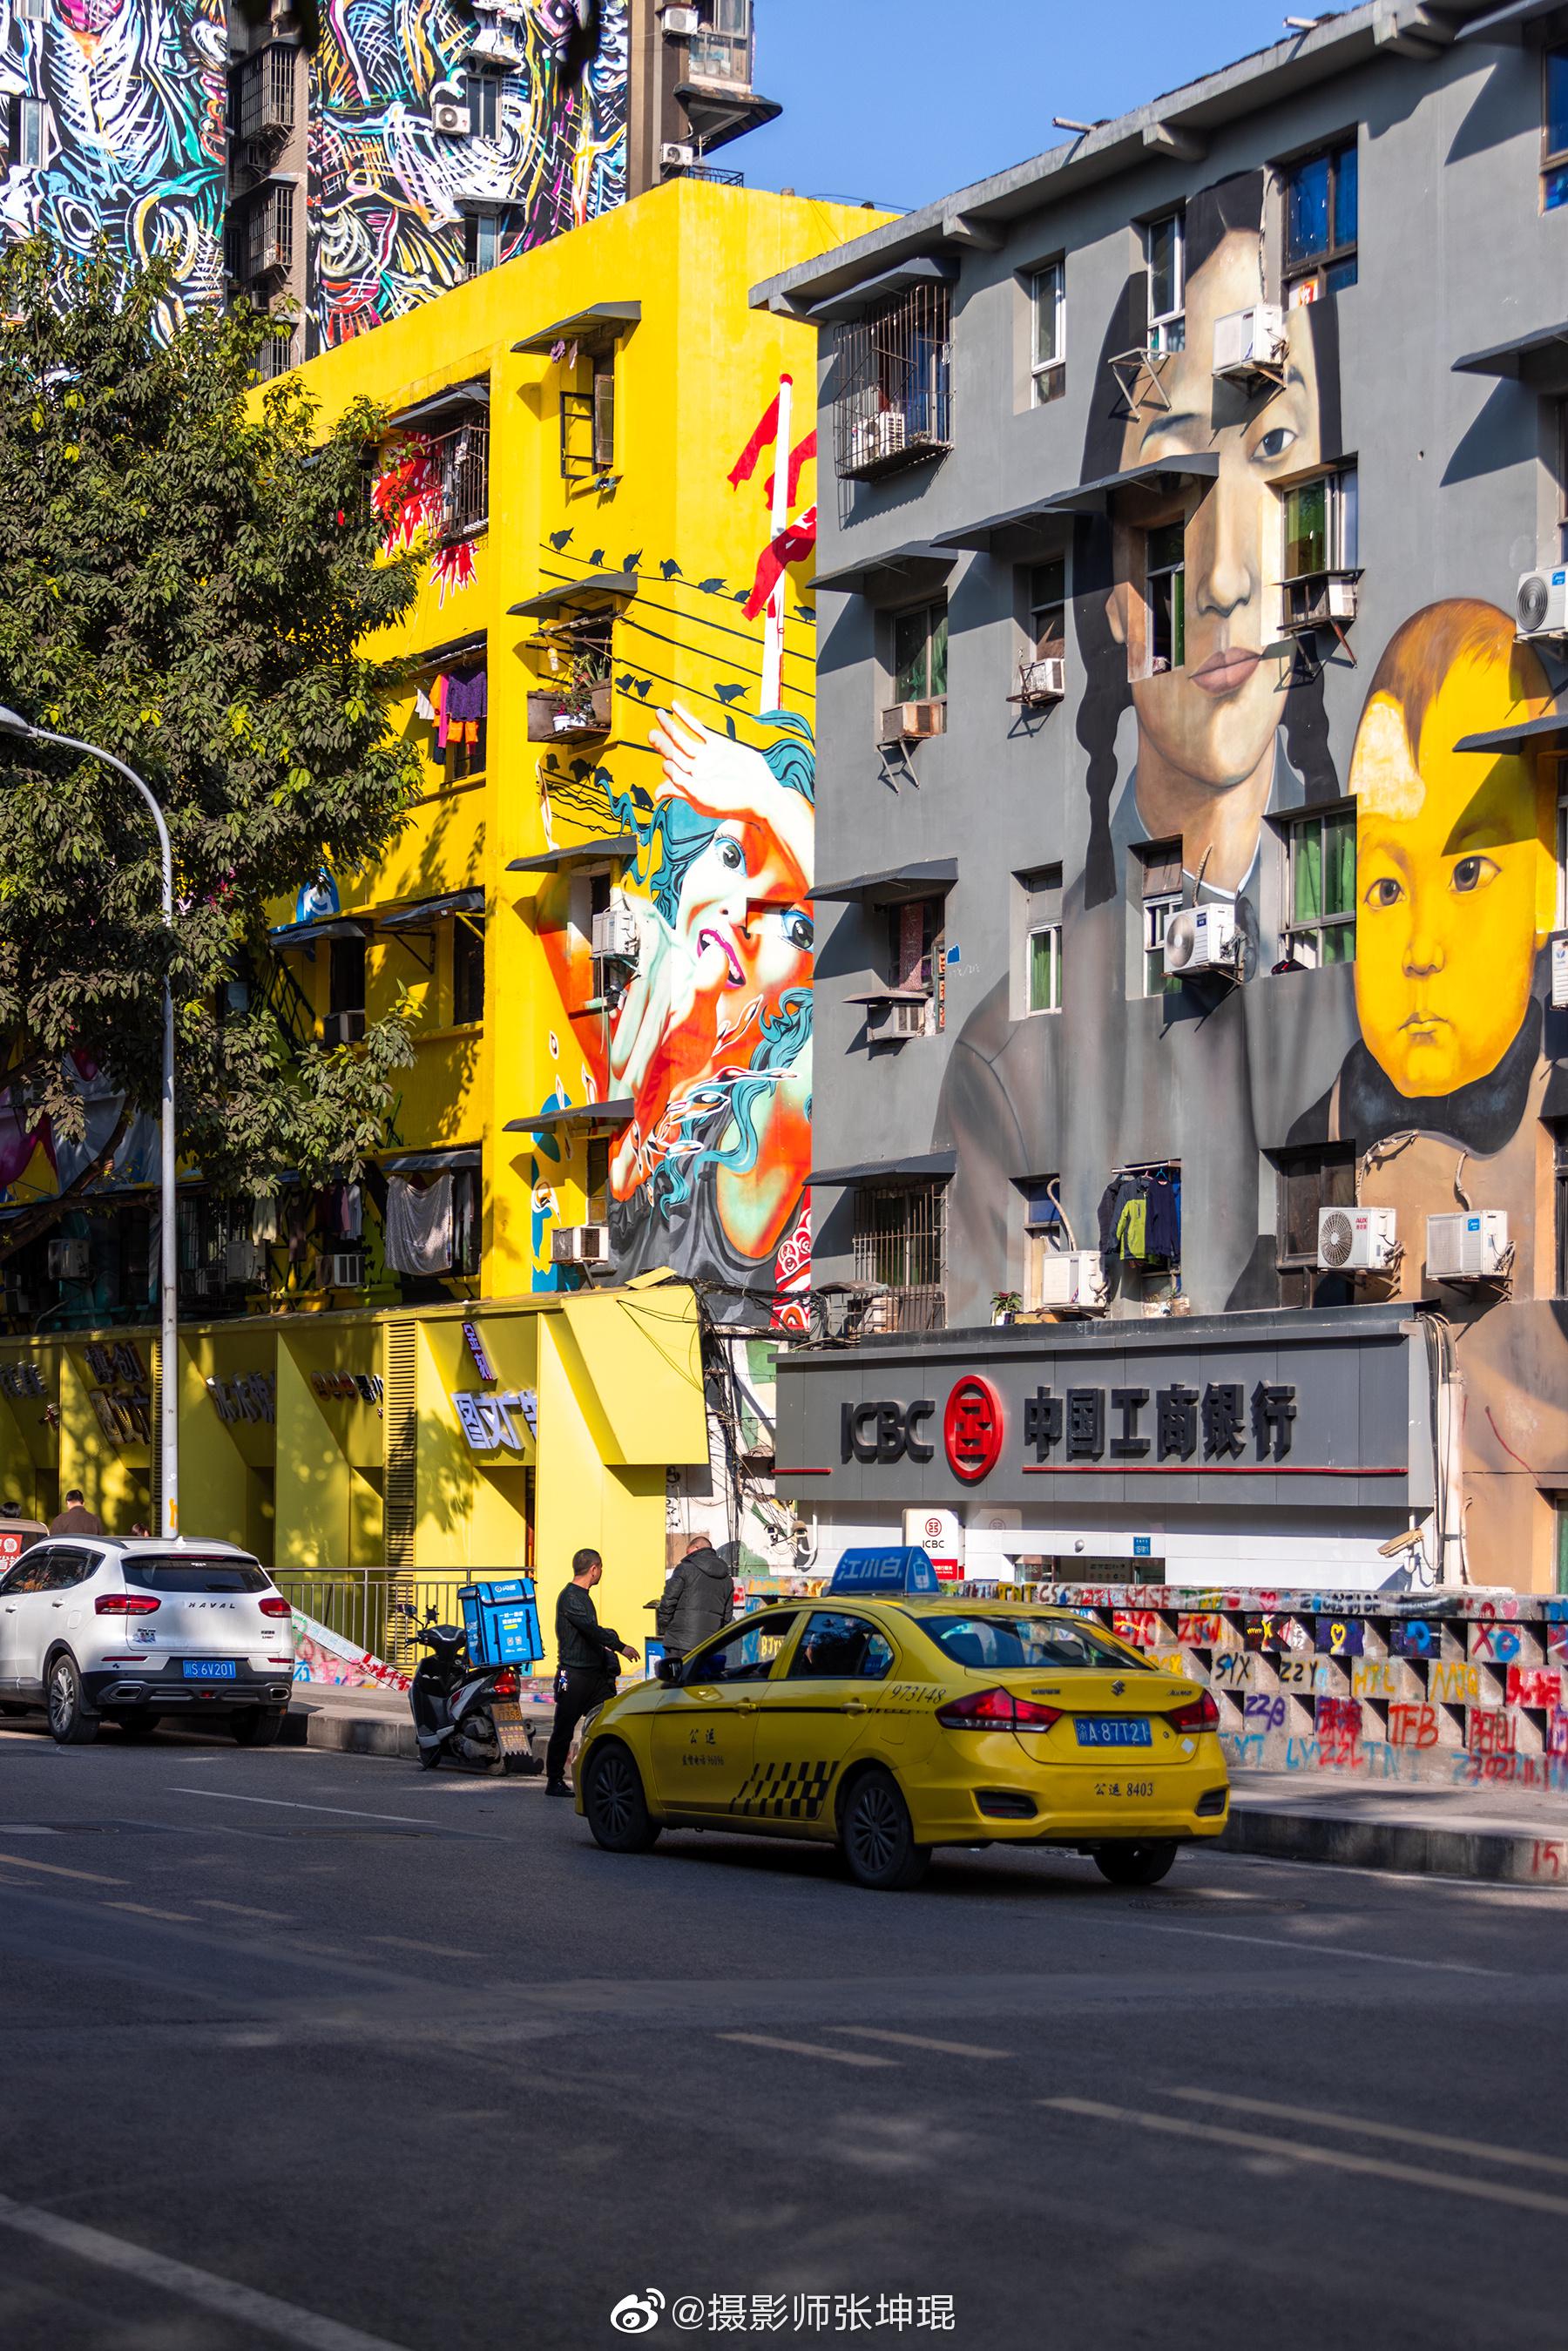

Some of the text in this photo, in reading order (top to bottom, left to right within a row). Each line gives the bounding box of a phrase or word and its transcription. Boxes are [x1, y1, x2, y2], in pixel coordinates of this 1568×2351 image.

[841, 1381, 1297, 1465] ICBC 中国工商银行
[923, 1540, 944, 1549] ICBC
[890, 1685, 947, 1705] 973148
[1127, 1782, 1153, 1796] 8403
